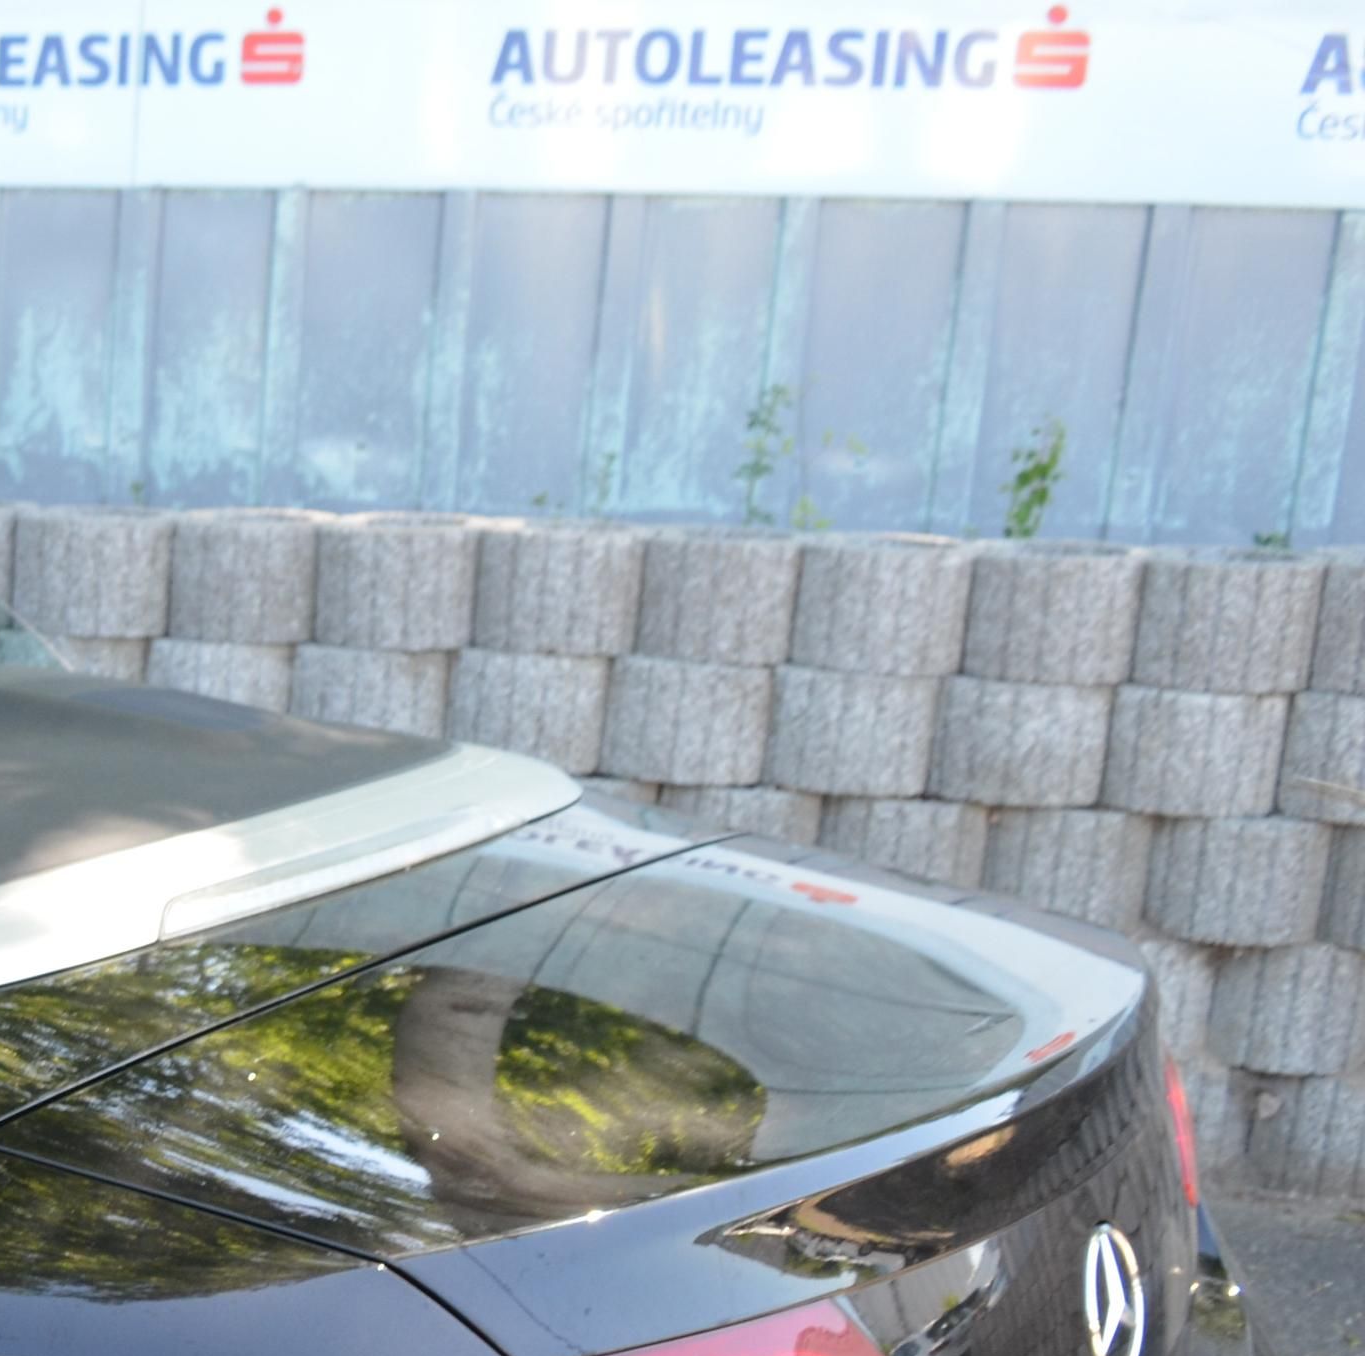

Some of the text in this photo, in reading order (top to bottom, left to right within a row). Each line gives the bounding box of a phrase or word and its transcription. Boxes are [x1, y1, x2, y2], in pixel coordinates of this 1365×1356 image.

[489, 28, 999, 89] AUTOLEASING
[1298, 33, 1365, 95] A
[1296, 100, 1365, 141] Čes
